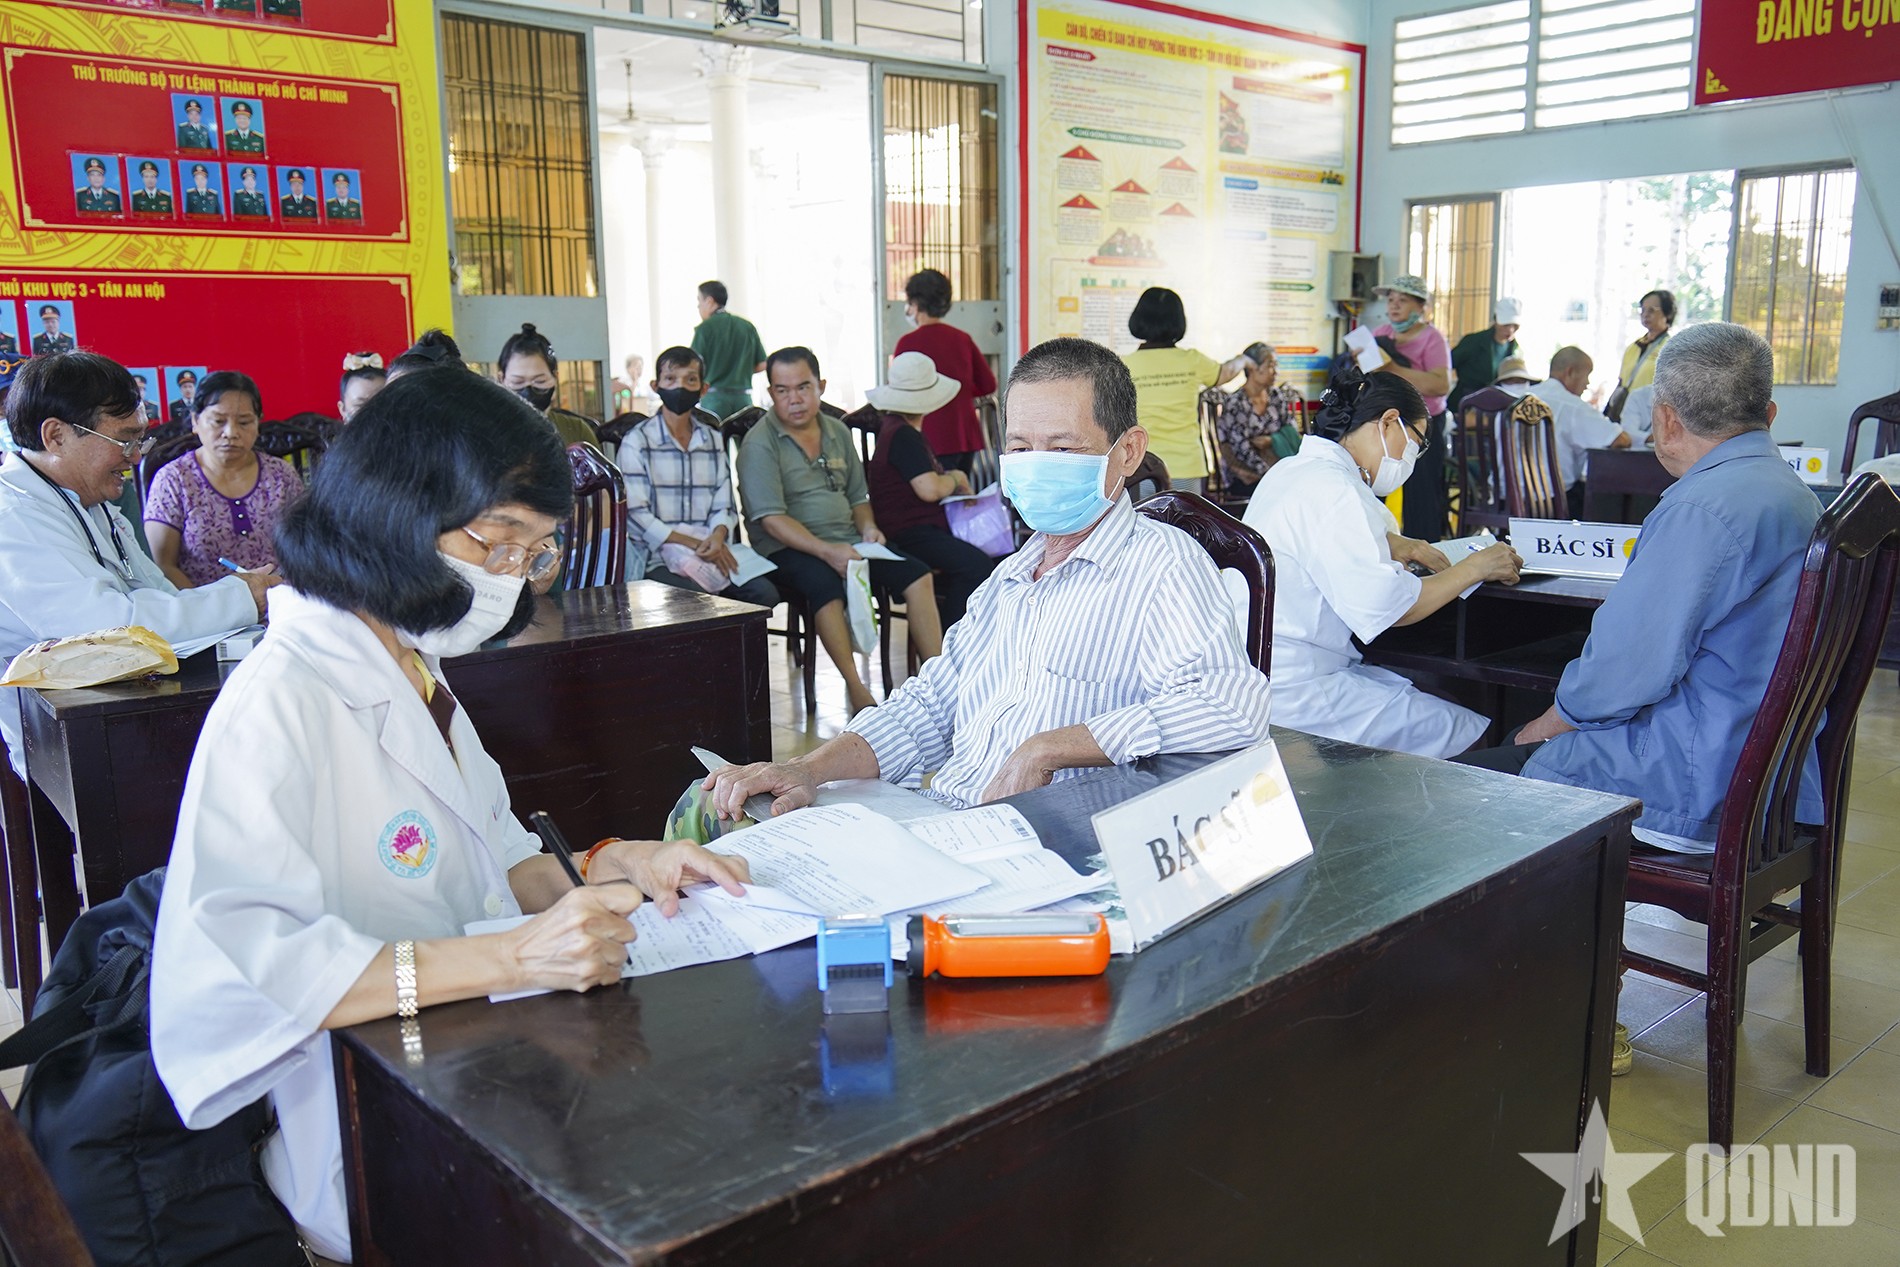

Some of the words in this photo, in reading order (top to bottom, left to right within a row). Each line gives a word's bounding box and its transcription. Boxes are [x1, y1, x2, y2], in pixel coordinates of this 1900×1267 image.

[72, 62, 97, 81] THỦ
[99, 65, 148, 86] TRƯỞNG
[150, 70, 167, 91] BỘ
[168, 74, 185, 89] TƯ
[186, 73, 216, 93] LỆNH
[218, 77, 255, 96] THÀNH
[257, 80, 280, 98] PHỐ
[282, 82, 298, 100] HỒ
[299, 85, 318, 101] CHÍ
[319, 88, 348, 104] MINH
[0, 277, 20, 297] HỦ
[22, 281, 49, 297] KHU
[51, 281, 77, 300] VỰC
[78, 283, 88, 298] 3
[97, 280, 123, 298] TÂN
[125, 283, 143, 299] AN
[144, 281, 165, 301] HỘI
[1535, 534, 1586, 557] BÁC
[1592, 538, 1615, 559] SĨ
[1146, 815, 1215, 883] BÁC
